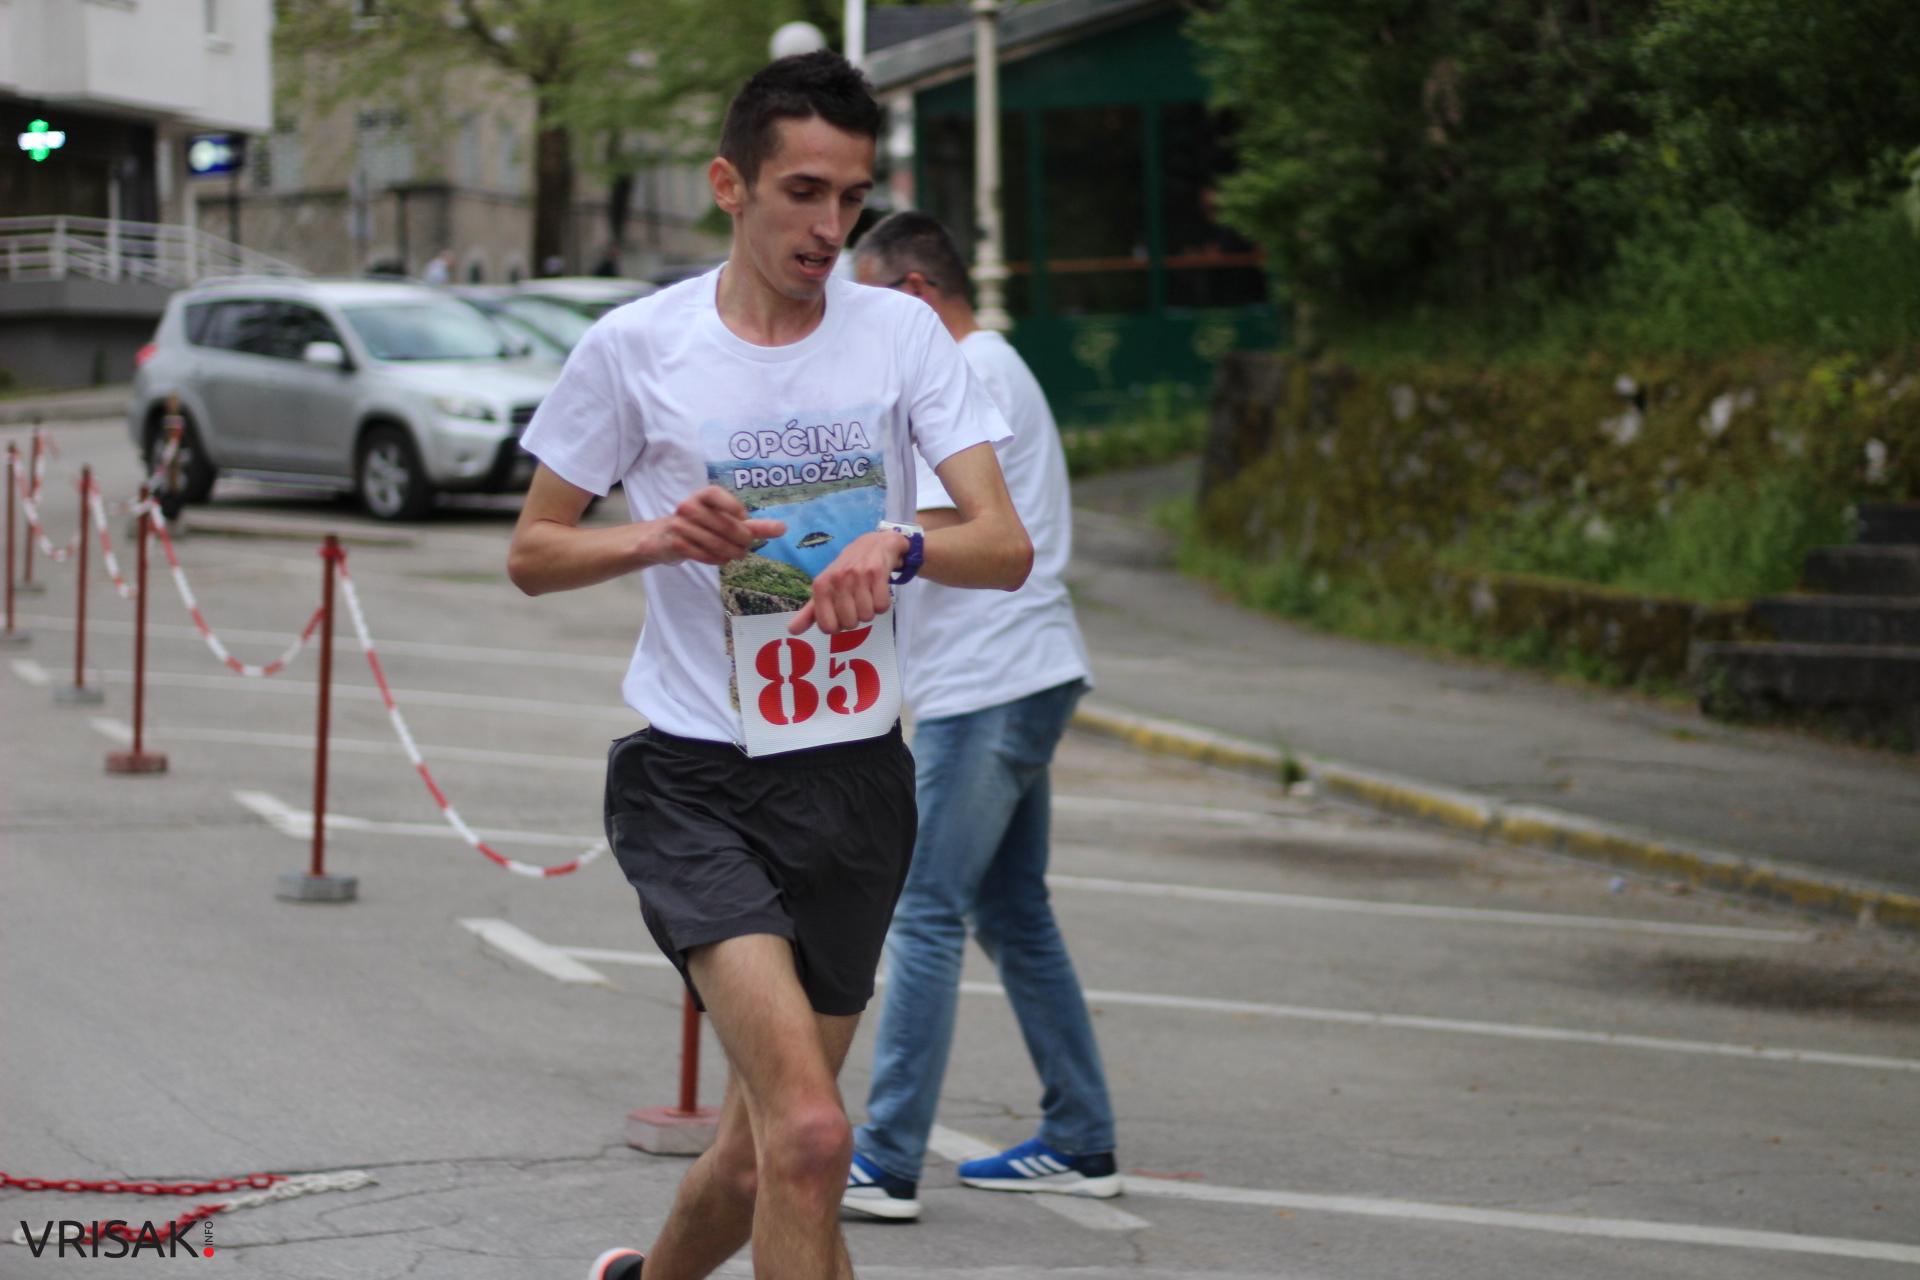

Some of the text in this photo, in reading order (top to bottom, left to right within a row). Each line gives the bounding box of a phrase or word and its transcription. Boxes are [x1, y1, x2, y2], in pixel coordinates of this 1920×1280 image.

[729, 420, 870, 460] OPĆINA
[734, 454, 870, 489] PROLOŽAC
[755, 625, 880, 725] 85
